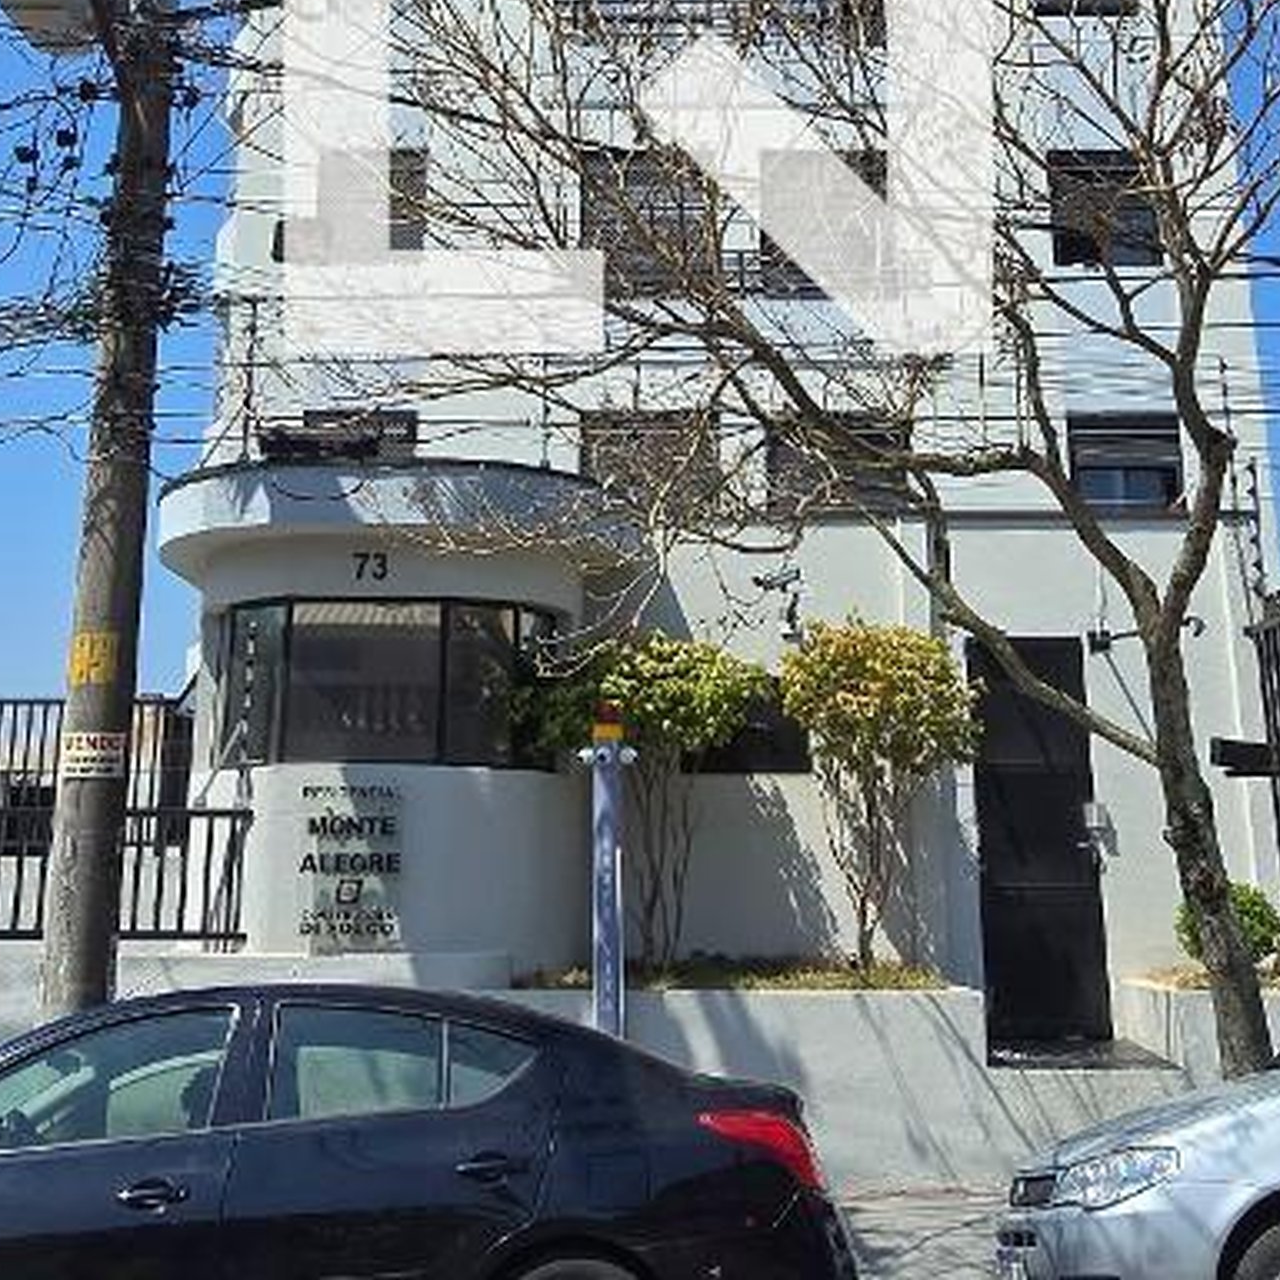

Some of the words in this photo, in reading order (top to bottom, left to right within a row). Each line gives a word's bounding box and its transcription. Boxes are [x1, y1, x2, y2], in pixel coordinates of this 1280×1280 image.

[352, 552, 388, 580] 73
[308, 816, 397, 836] MONTE
[299, 852, 402, 873] ALEGRE
